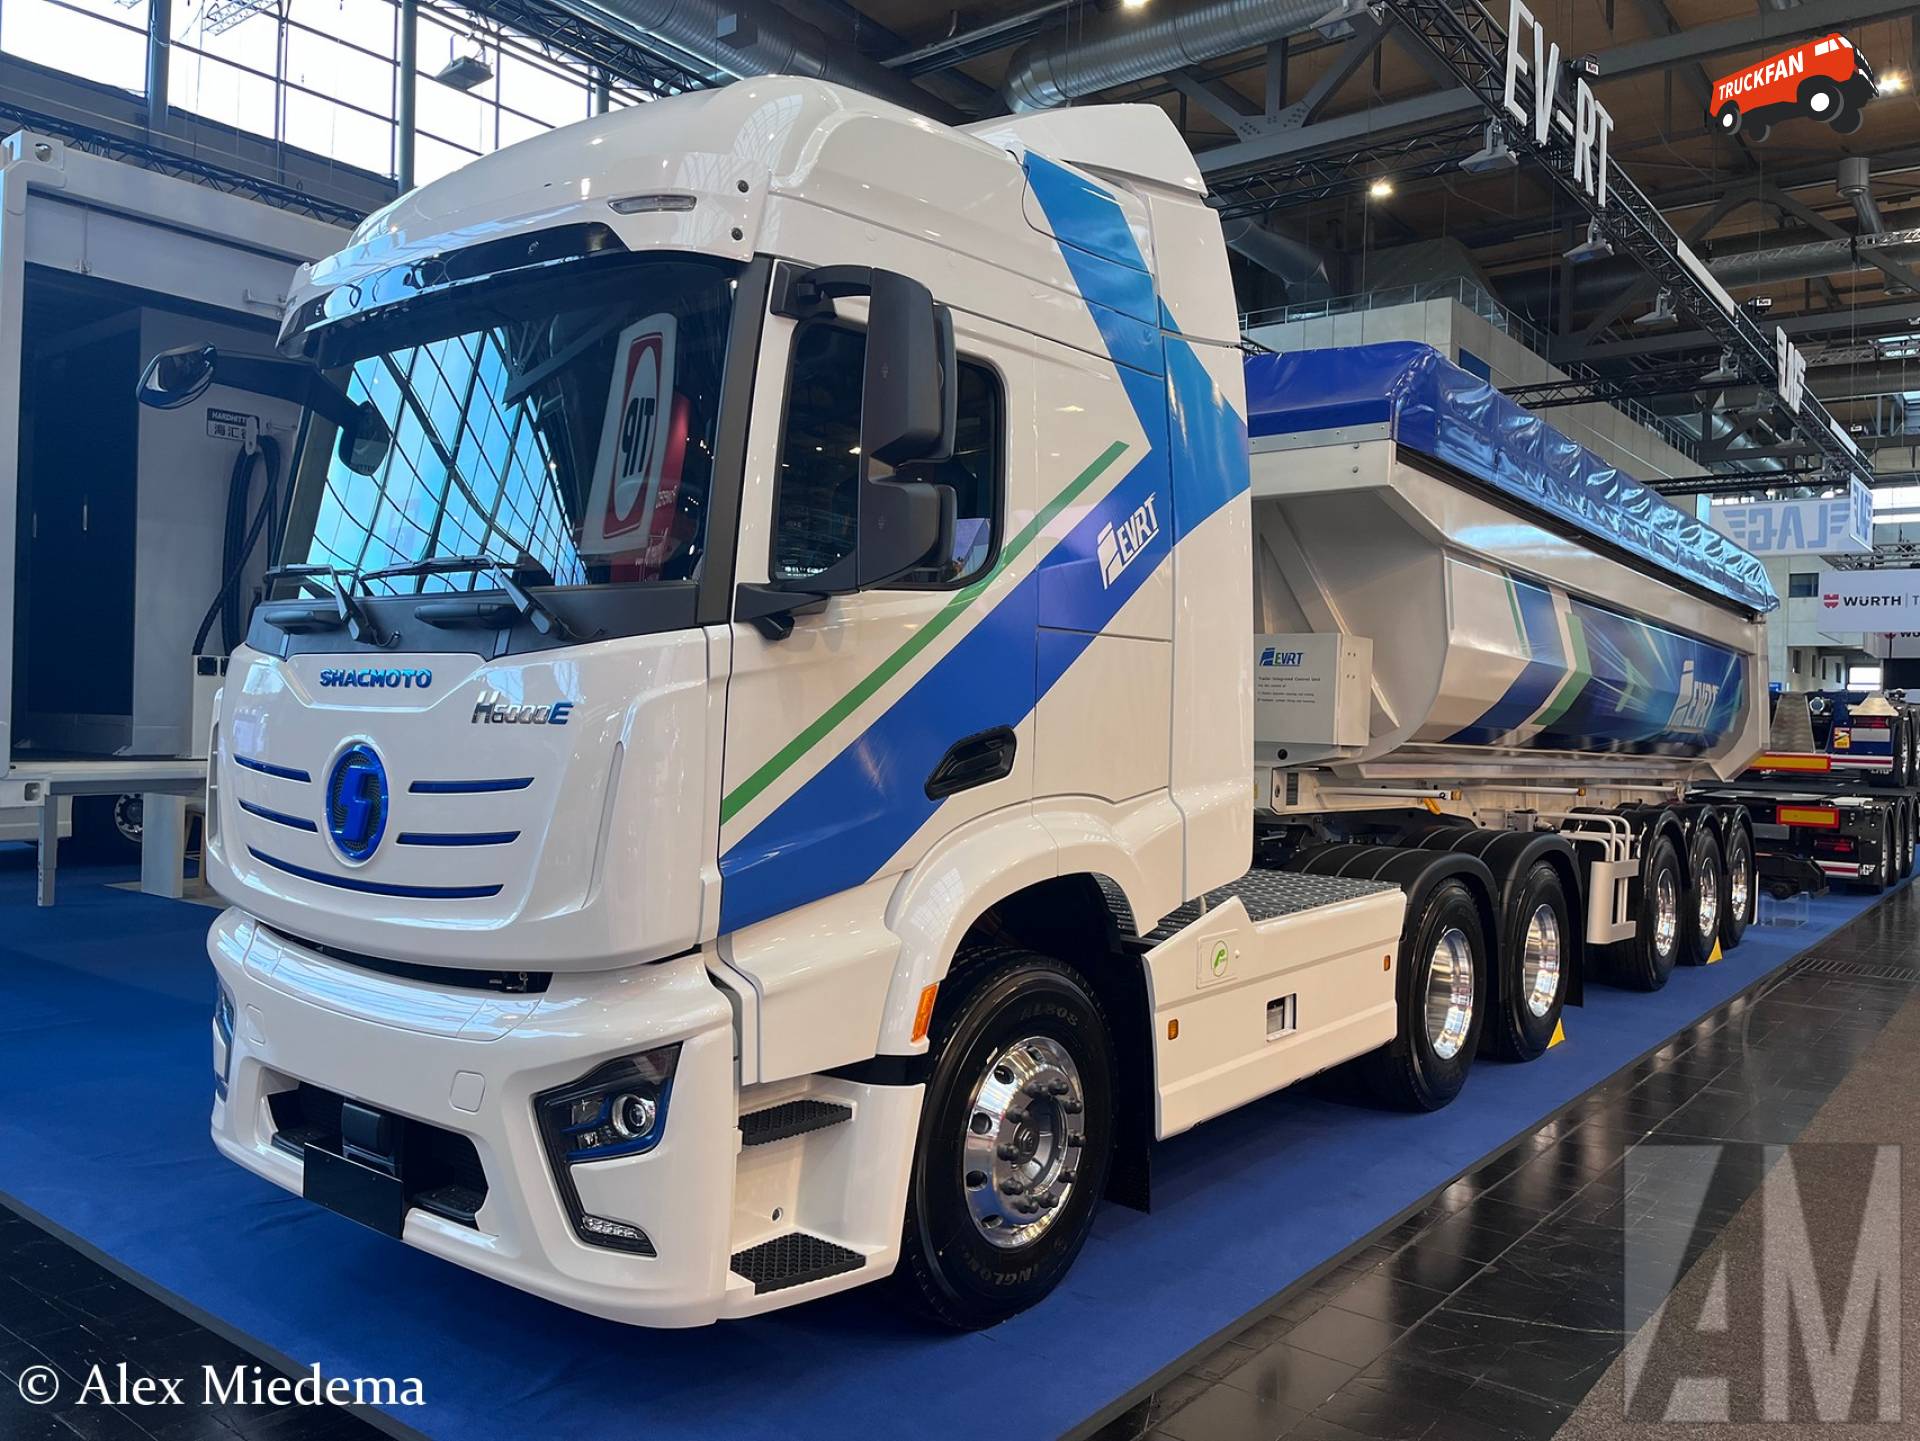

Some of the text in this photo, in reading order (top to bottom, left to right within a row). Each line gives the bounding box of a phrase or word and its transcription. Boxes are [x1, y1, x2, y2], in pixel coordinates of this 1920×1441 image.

[1117, 491, 1159, 562] EVRT
[1274, 652, 1304, 665] EVRT
[319, 668, 432, 689] SHACMOTO
[1682, 681, 1720, 729] EVRT
